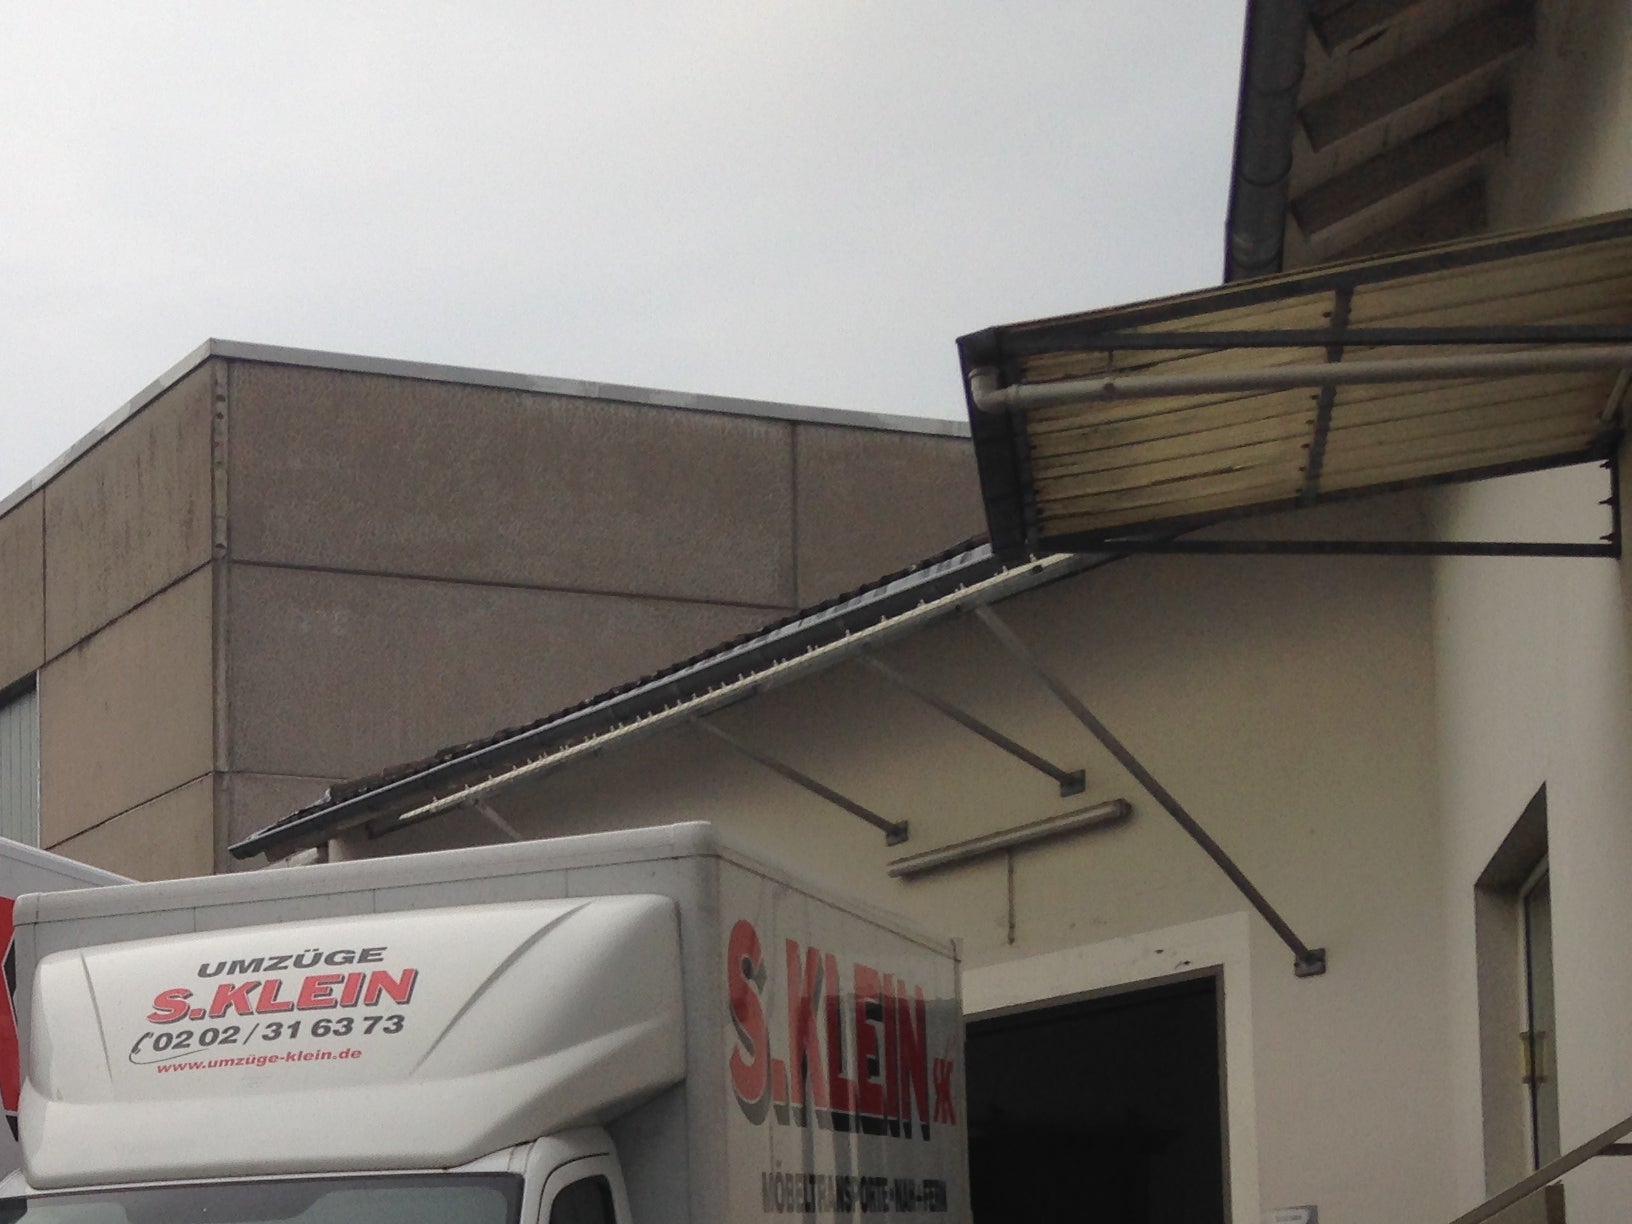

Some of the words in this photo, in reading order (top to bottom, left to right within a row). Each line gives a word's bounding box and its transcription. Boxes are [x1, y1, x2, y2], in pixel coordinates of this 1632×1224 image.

[197, 946, 387, 978] UMZÜGE
[147, 968, 419, 1024] S.KLEIN
[727, 919, 930, 1141] S.KLEIN
[157, 1048, 362, 1074] www.umzüge-klein.de
